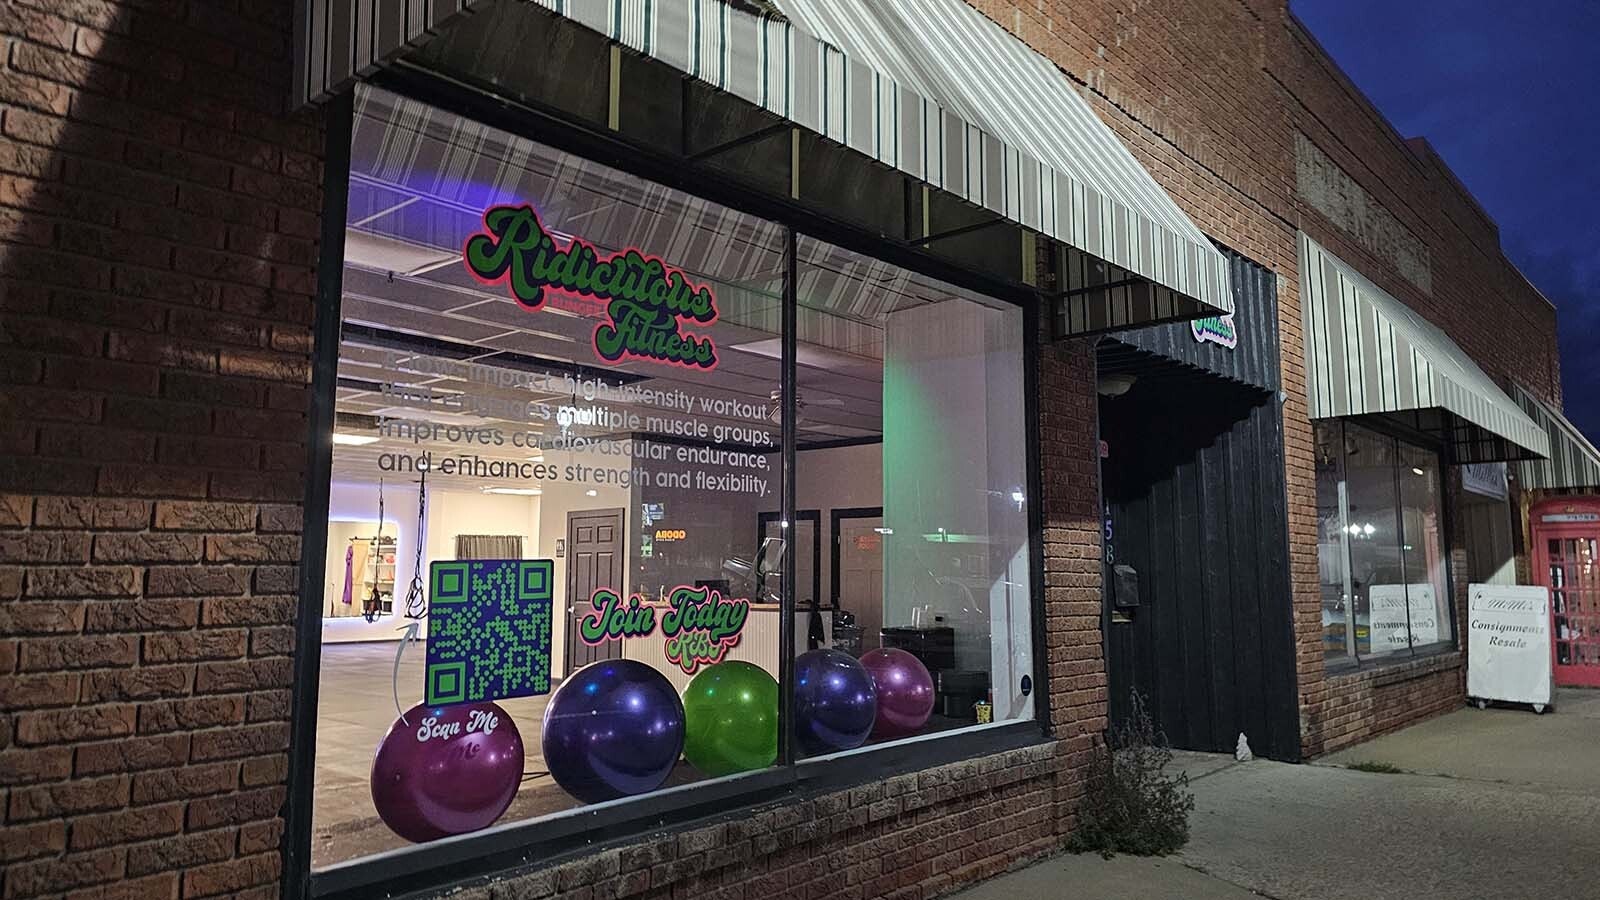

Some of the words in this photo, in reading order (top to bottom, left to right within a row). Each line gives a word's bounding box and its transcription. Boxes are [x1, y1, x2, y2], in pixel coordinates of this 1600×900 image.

[465, 204, 718, 324] Ridiculous
[595, 299, 717, 368] Fitness
[559, 405, 640, 430] multiple
[646, 416, 708, 437] muscle
[713, 424, 774, 447] groups,
[700, 398, 767, 420] workout
[378, 416, 504, 446] improves
[512, 430, 671, 460] cardiovascular
[676, 446, 770, 470] endurance,
[378, 452, 431, 473] and
[441, 456, 557, 480] enhances
[565, 463, 649, 489] strength
[656, 471, 690, 489] and
[696, 470, 770, 497] flexibility.
[581, 590, 656, 643] Join
[662, 587, 750, 643] Today
[1489, 636, 1527, 648] Resale
[416, 716, 461, 742] Scan
[466, 710, 499, 735] Me
